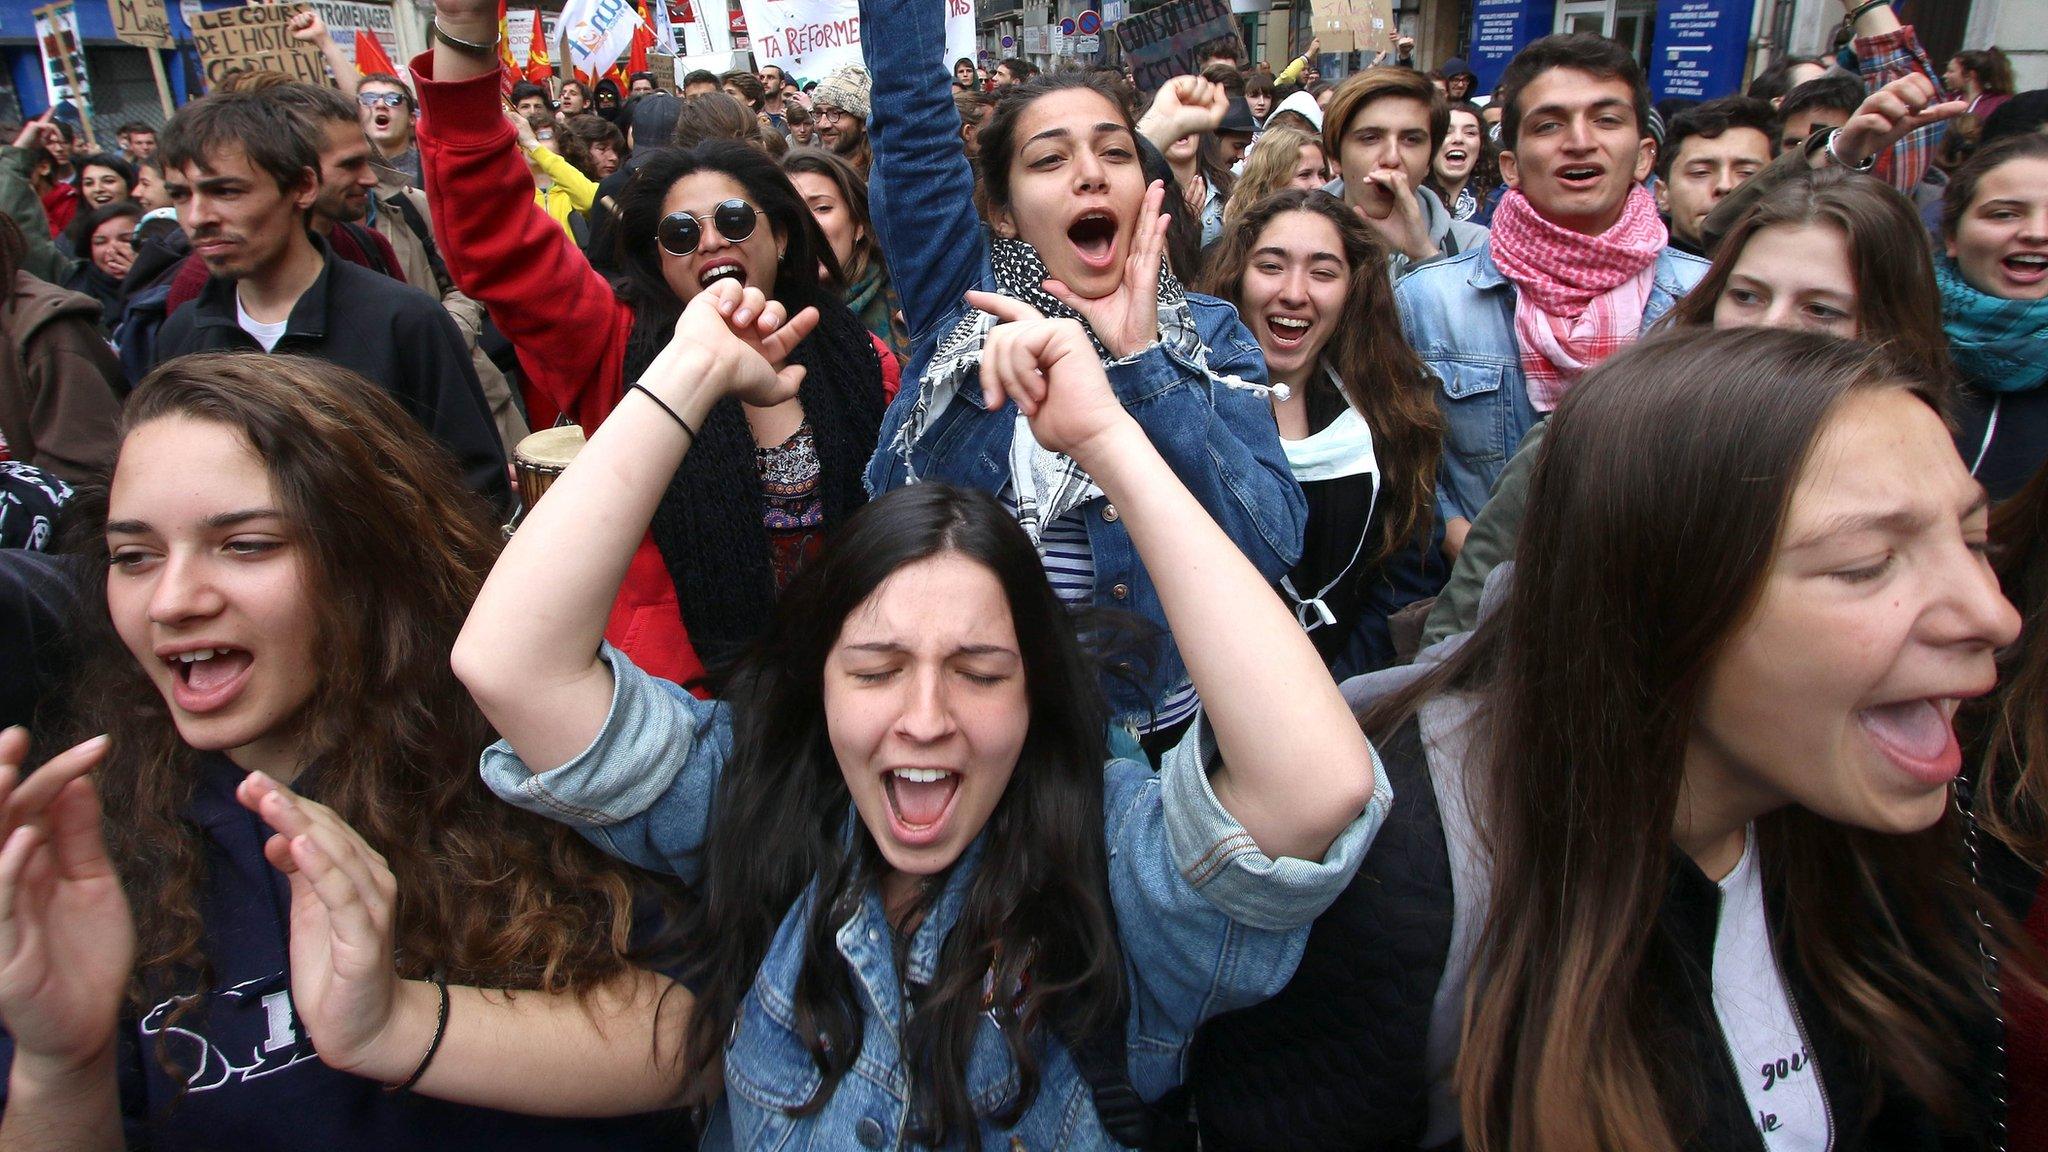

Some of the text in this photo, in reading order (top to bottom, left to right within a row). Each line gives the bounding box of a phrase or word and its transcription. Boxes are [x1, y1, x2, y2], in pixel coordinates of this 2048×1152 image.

[199, 10, 235, 29] LE
[310, 2, 393, 29] TROMENAGER
[196, 34, 219, 55] DE
[223, 23, 310, 55] L'HISTO
[758, 16, 861, 58] TA RÉFORME
